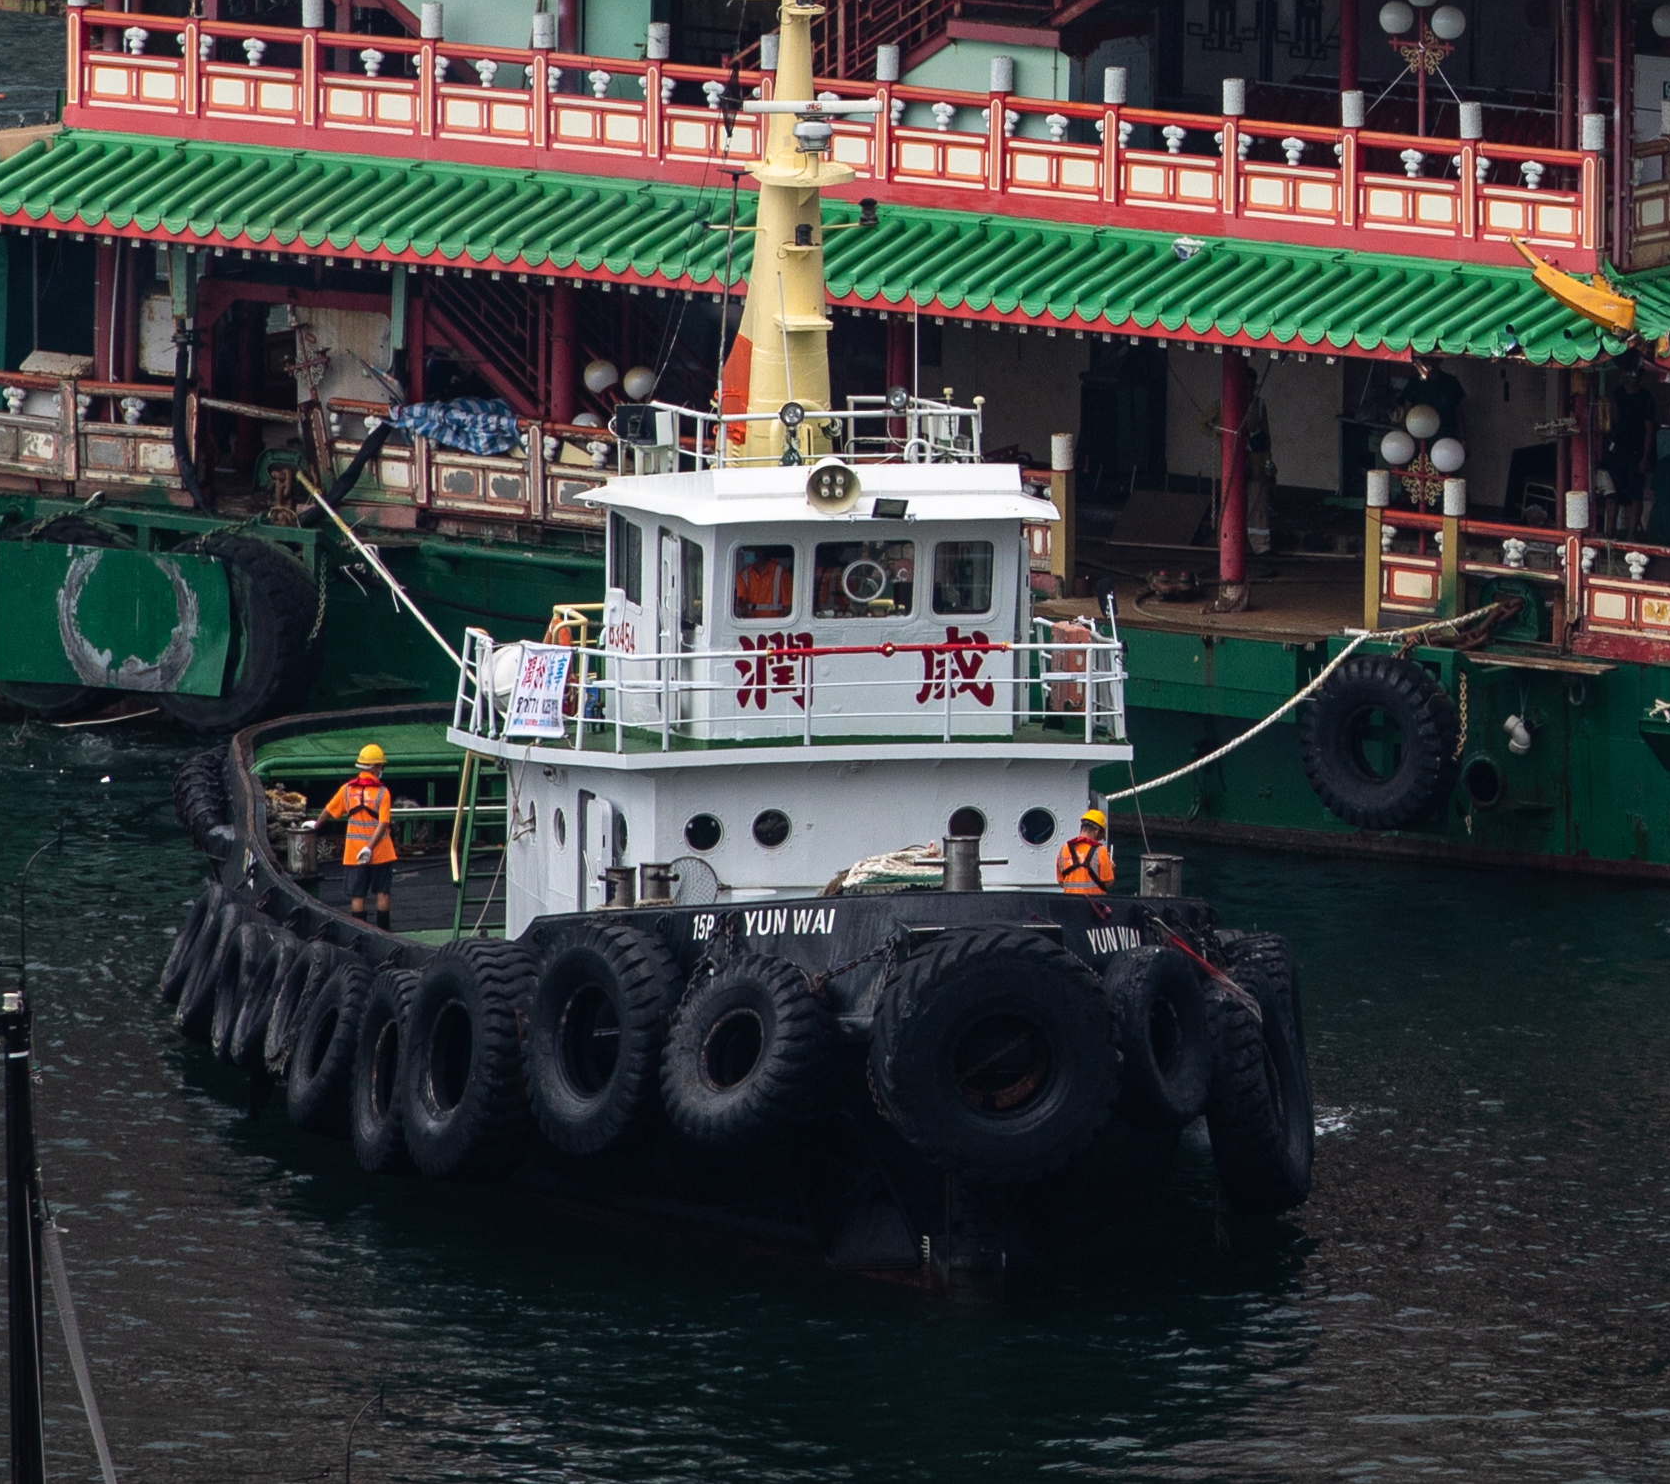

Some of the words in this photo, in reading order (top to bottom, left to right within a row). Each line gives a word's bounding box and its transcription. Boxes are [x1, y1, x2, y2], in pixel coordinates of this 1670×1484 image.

[745, 910, 788, 937] YUN
[793, 908, 836, 936] WAI
[1086, 926, 1118, 955] YUN
[1117, 926, 1142, 952] WAI
